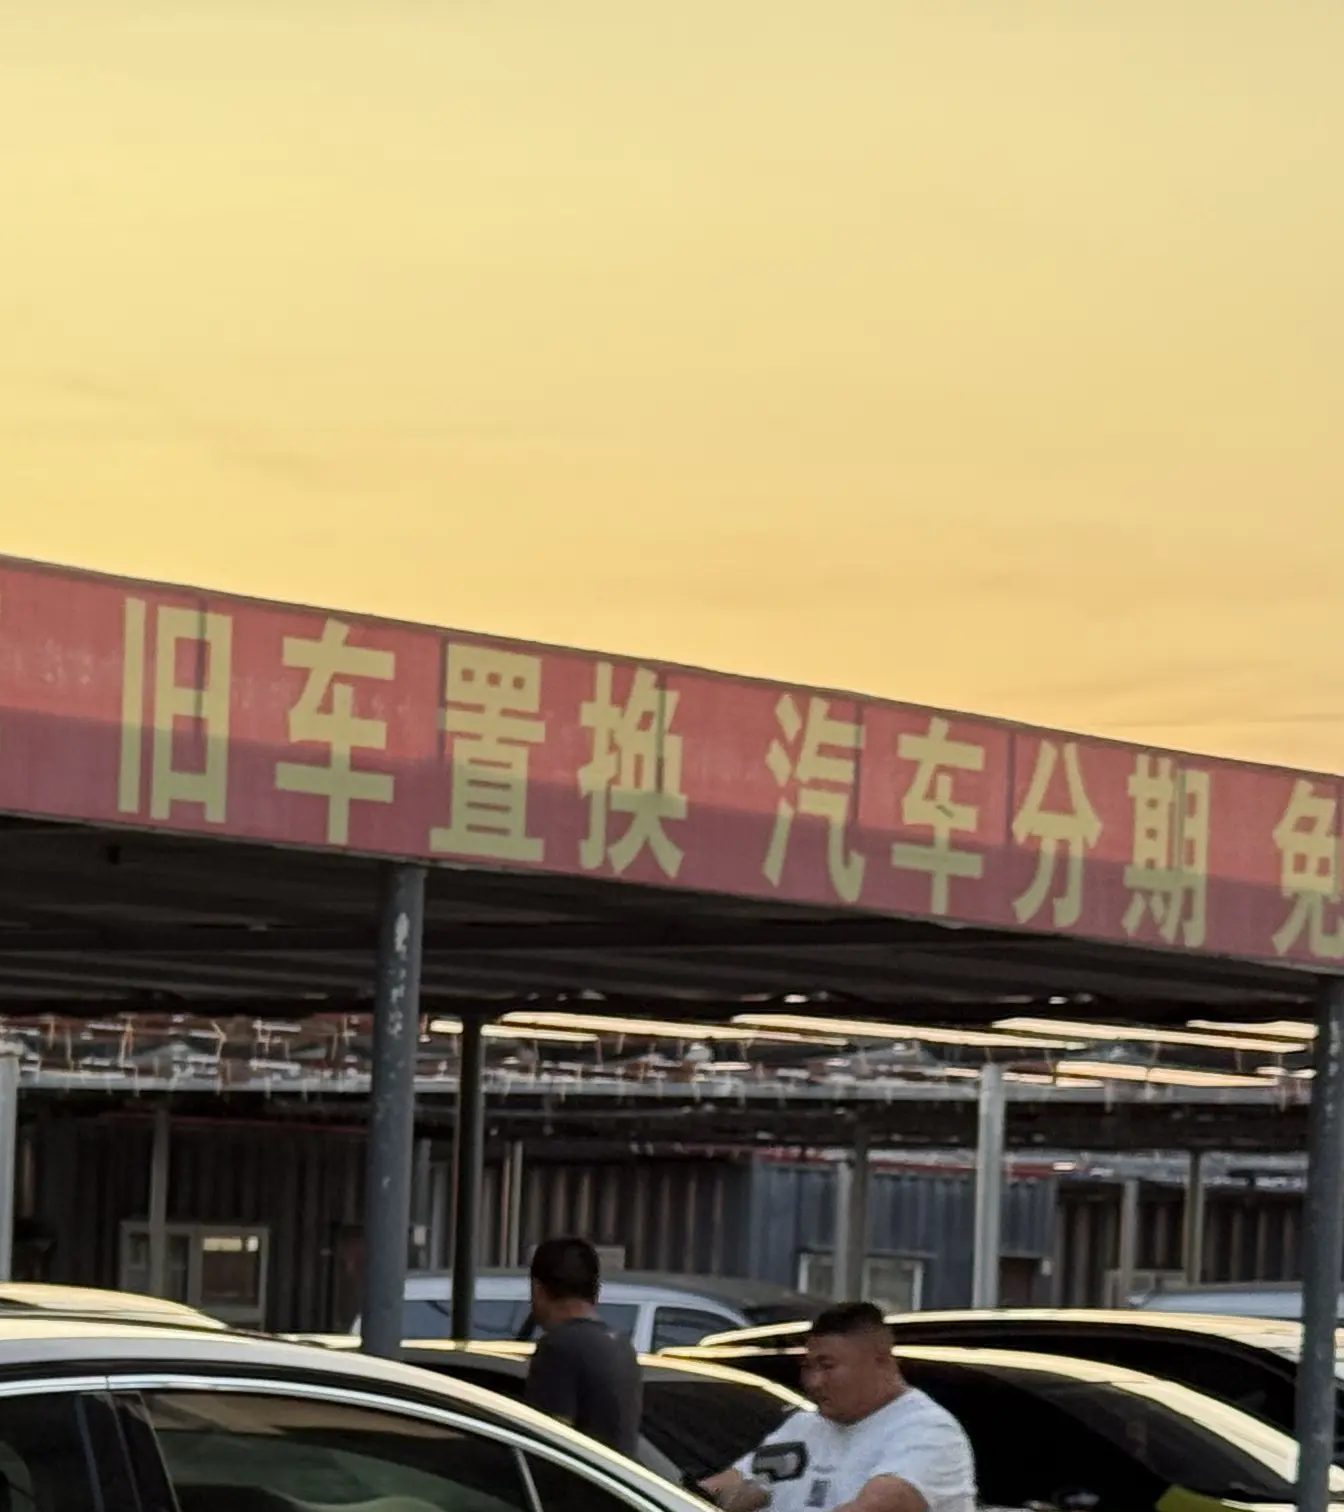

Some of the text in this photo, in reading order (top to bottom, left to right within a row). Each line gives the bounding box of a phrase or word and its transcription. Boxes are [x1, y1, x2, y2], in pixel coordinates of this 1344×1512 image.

[118, 597, 686, 879] 旧车置换
[763, 693, 1210, 947] 汽车分期
